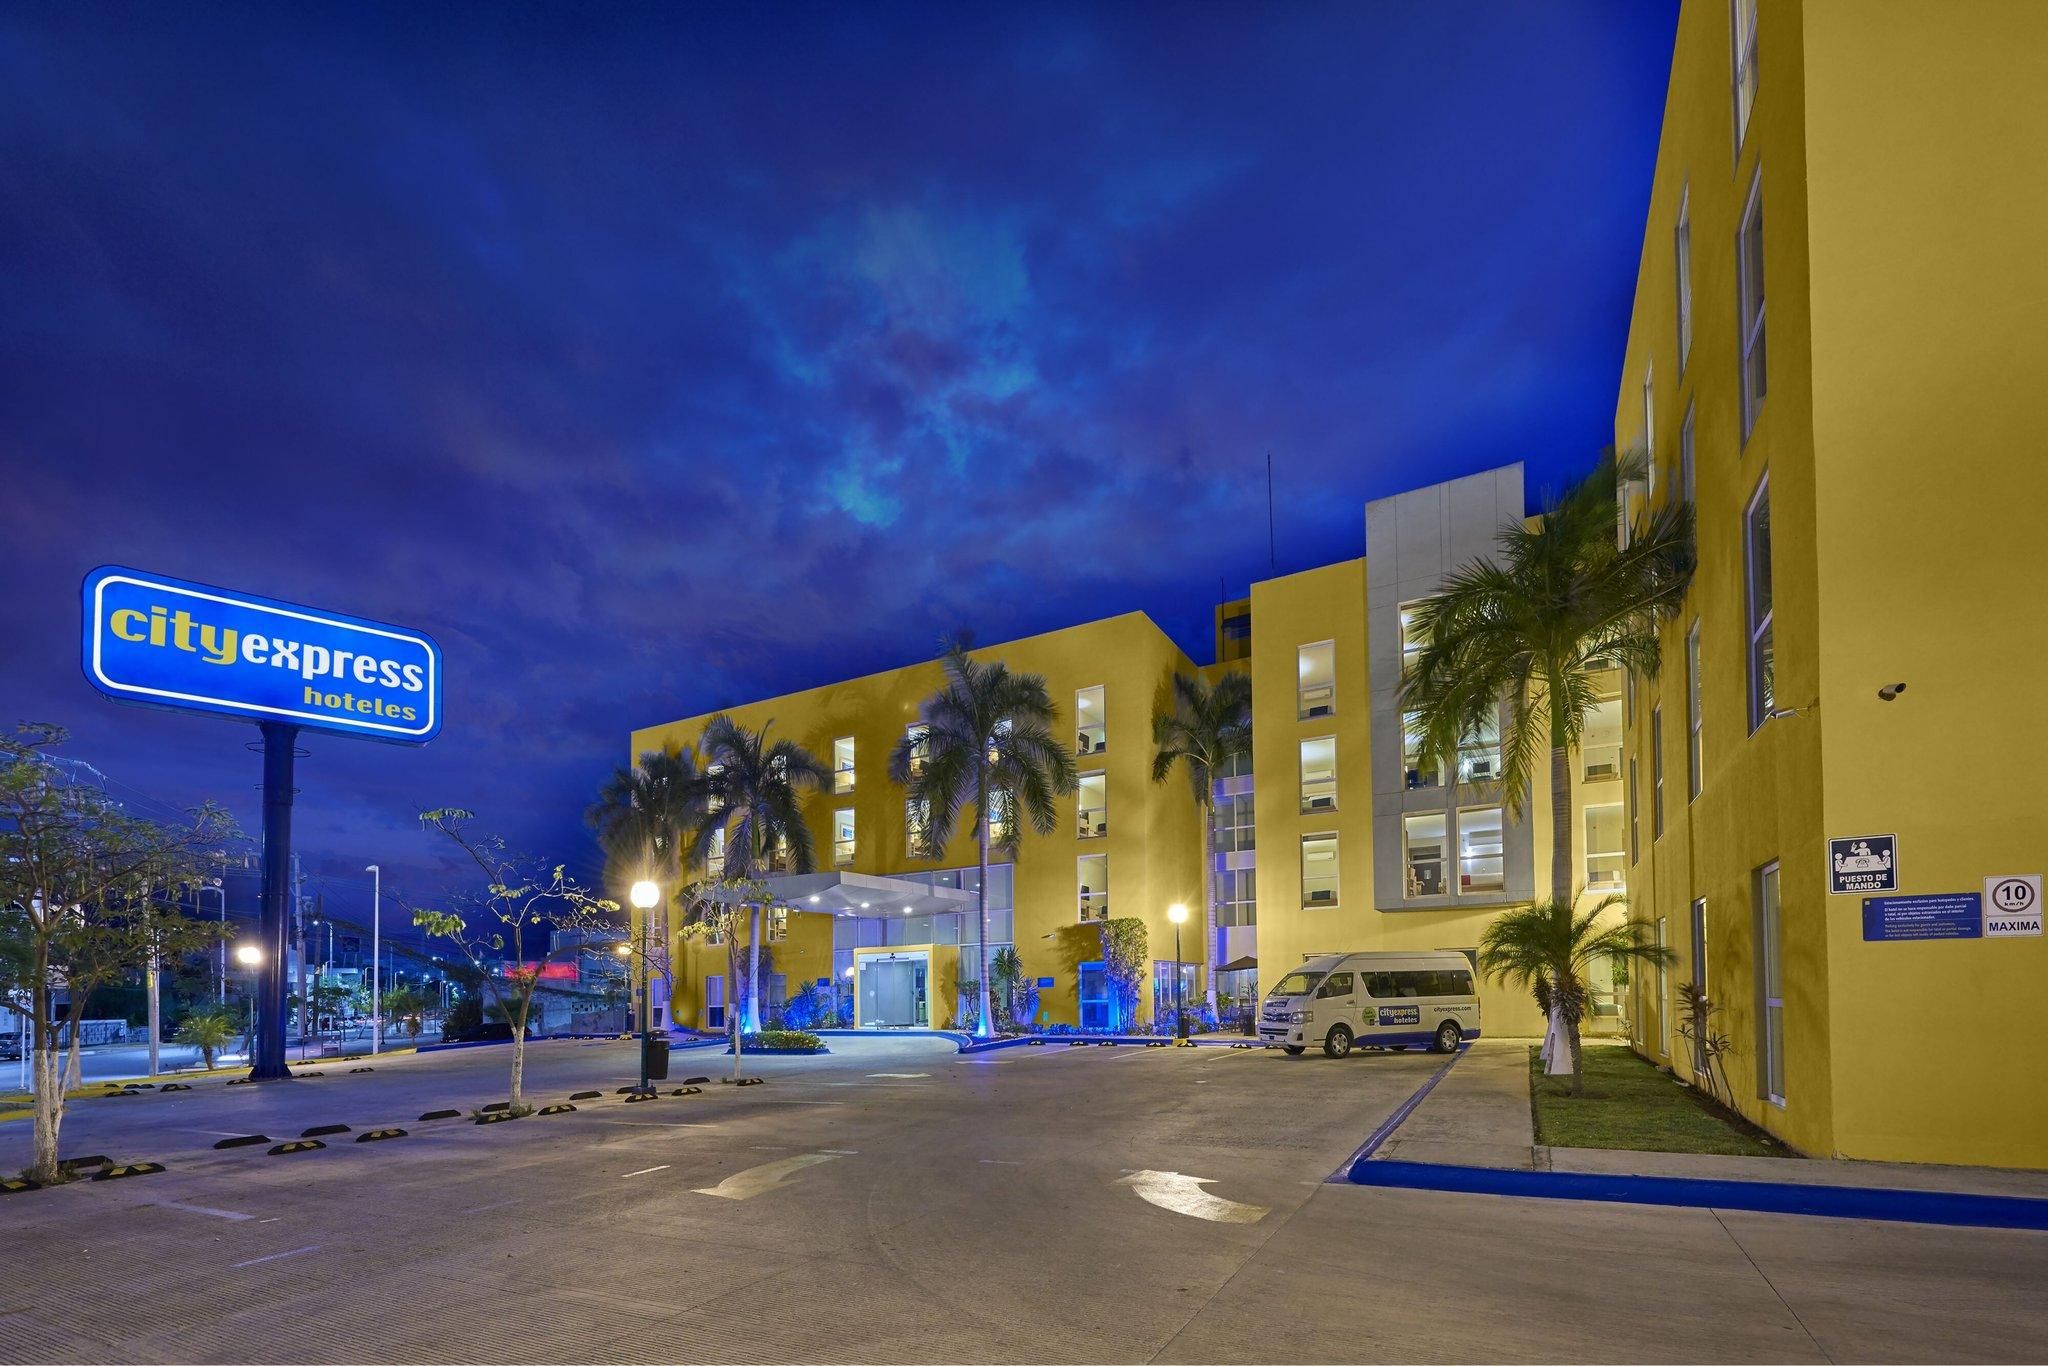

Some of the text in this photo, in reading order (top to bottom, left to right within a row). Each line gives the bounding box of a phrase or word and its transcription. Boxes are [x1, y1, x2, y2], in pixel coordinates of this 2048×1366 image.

[110, 606, 424, 692] cityexpress
[304, 686, 416, 721] hoteles
[1839, 873, 1888, 883] PUESTO DE
[1846, 881, 1882, 890] MANDO
[2002, 885, 2027, 900] 10
[1989, 921, 2040, 931] MAXIMA
[1379, 1007, 1418, 1017] cityexpress
